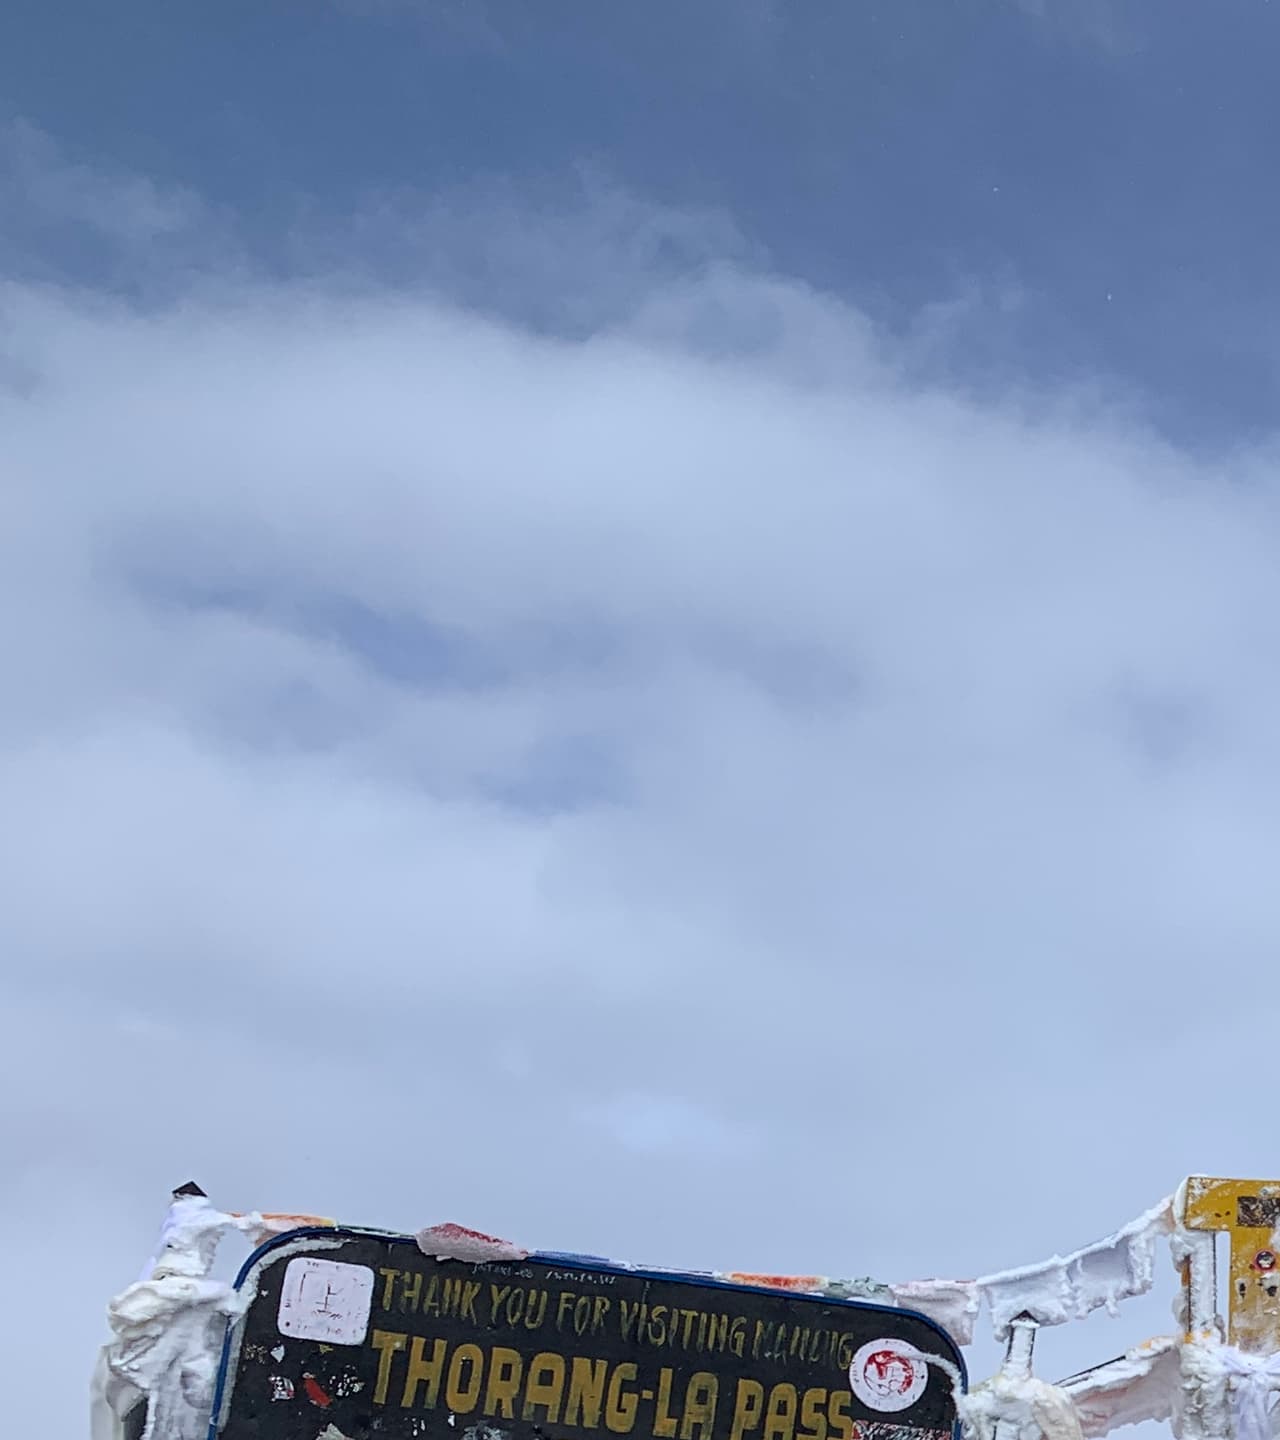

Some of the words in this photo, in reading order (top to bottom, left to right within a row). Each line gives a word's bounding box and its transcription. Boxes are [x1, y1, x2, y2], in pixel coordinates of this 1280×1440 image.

[379, 1267, 482, 1326] THANK
[490, 1283, 548, 1330] YOU
[556, 1291, 612, 1337] FOR
[619, 1299, 748, 1359] VISITING
